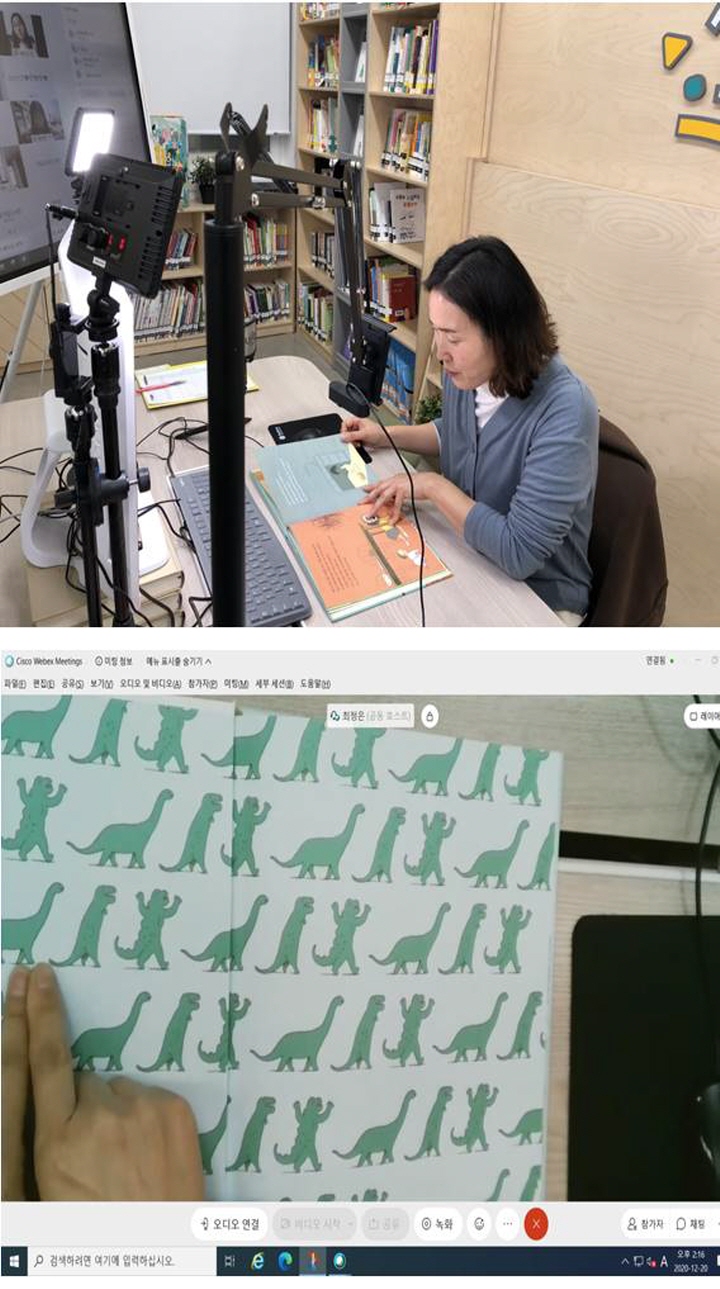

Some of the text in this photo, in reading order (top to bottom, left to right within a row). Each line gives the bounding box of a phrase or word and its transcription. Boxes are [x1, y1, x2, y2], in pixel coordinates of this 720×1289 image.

[16, 656, 83, 668] Cisco Webex Meetings
[120, 679, 141, 689] 오디오
[213, 1218, 260, 1231] 오디오 연결
[435, 1218, 454, 1231] 녹화
[641, 1218, 664, 1230] 참가자
[50, 1255, 92, 1267] 검색하려면
[94, 1255, 120, 1267] 여기에
[660, 1255, 668, 1268] A
